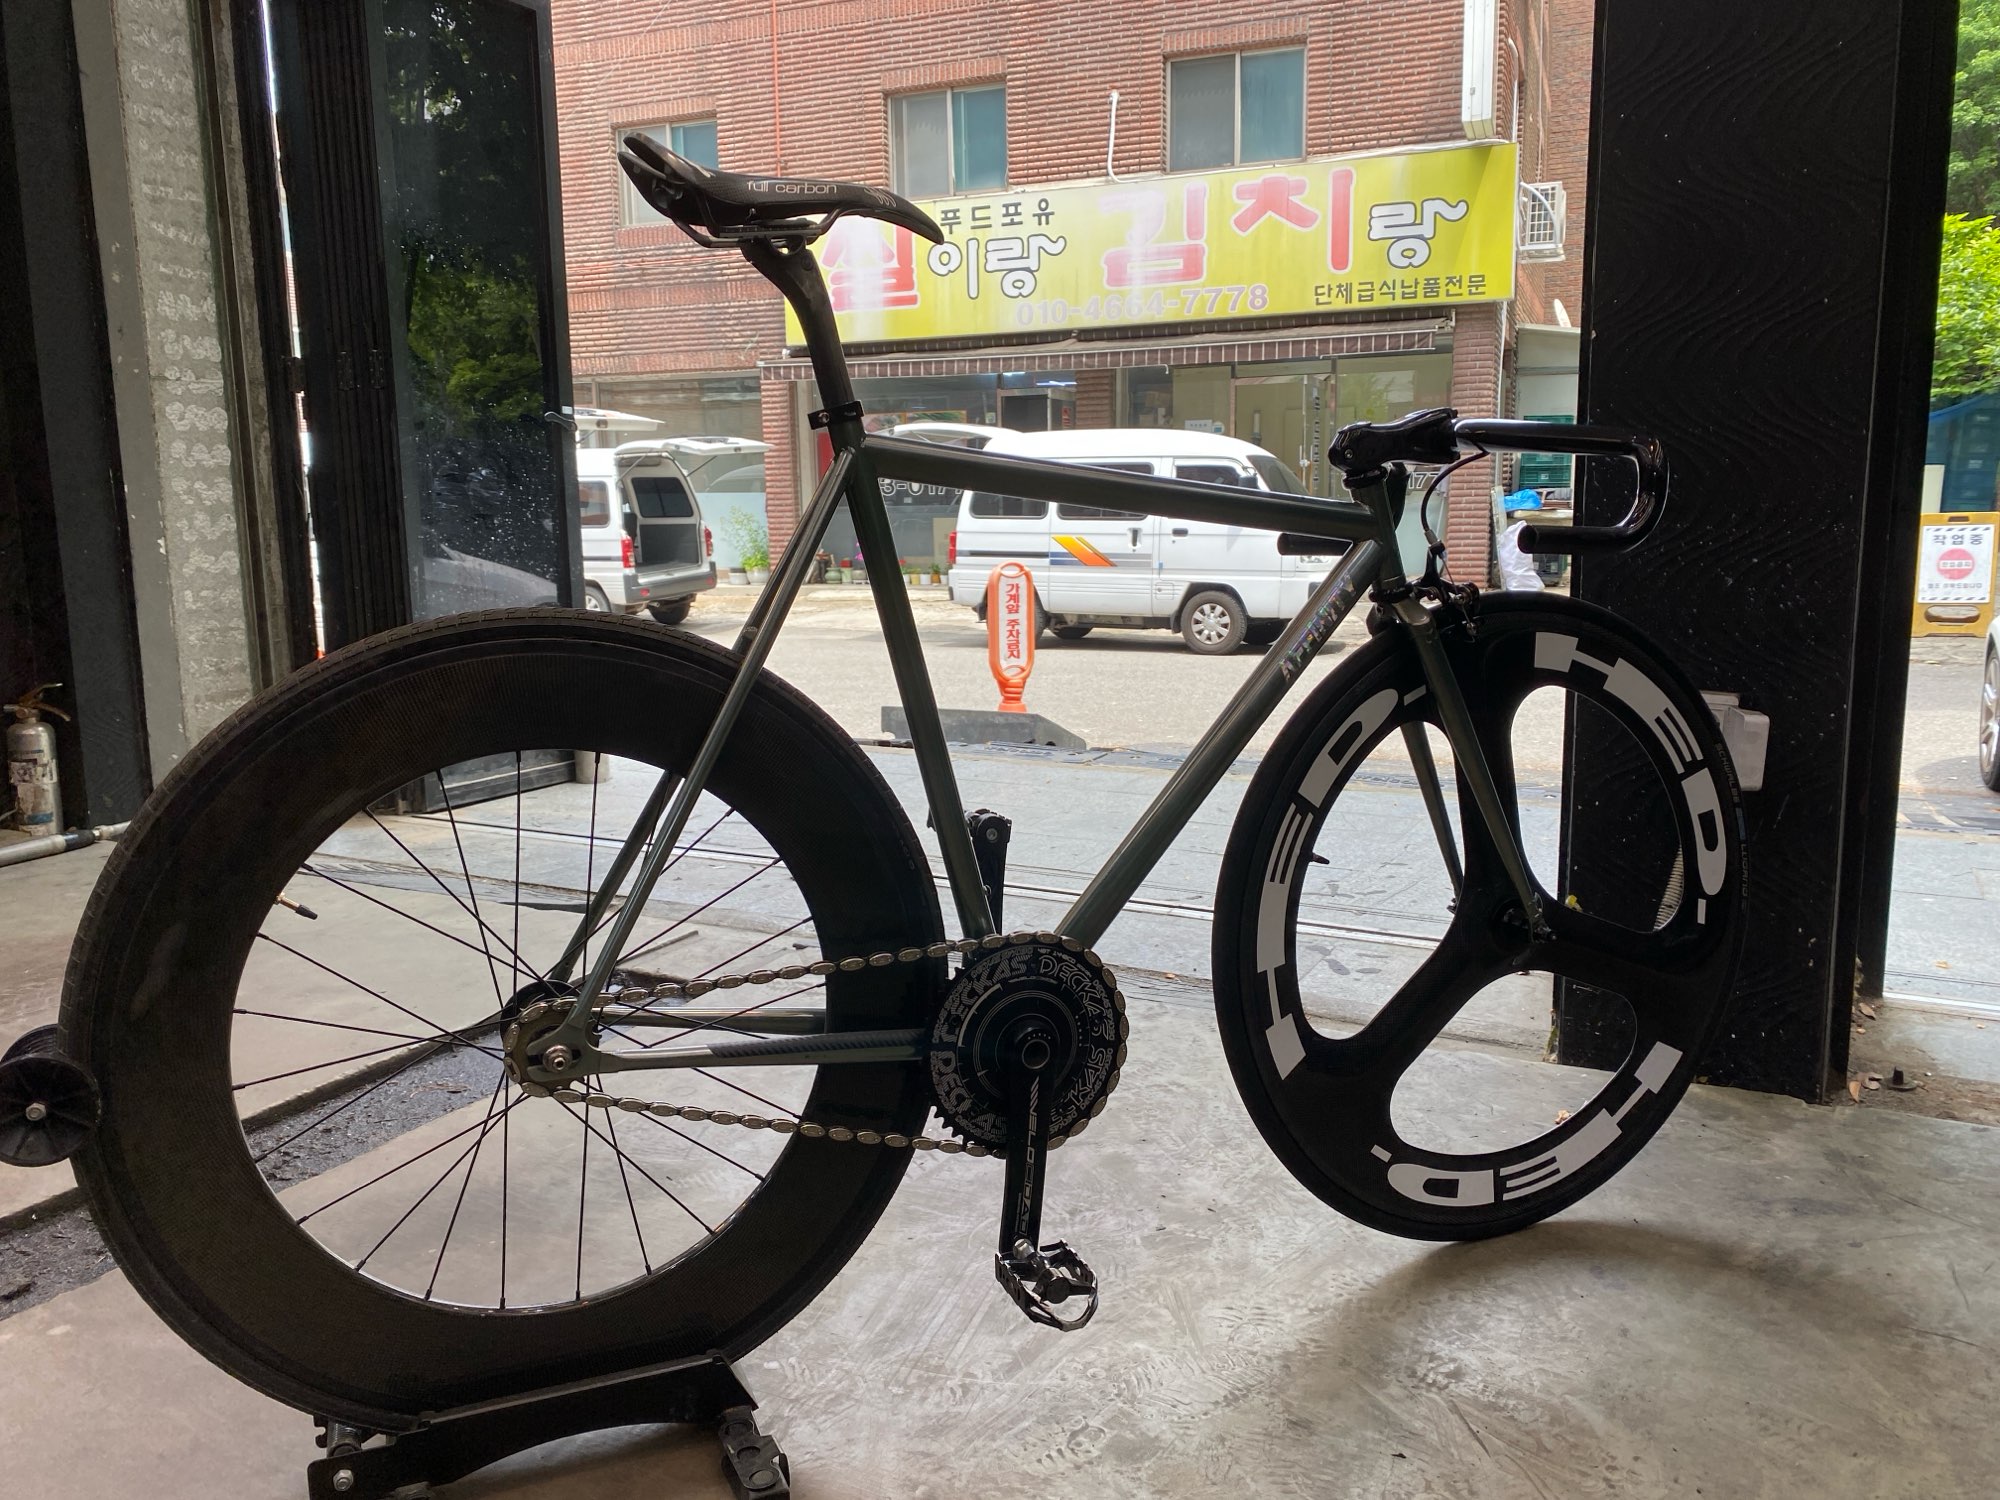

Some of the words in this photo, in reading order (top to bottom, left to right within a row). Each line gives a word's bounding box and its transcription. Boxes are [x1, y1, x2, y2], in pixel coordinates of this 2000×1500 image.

[747, 180, 769, 193] full
[775, 183, 837, 195] carbon
[940, 198, 1056, 235] 푸드포유
